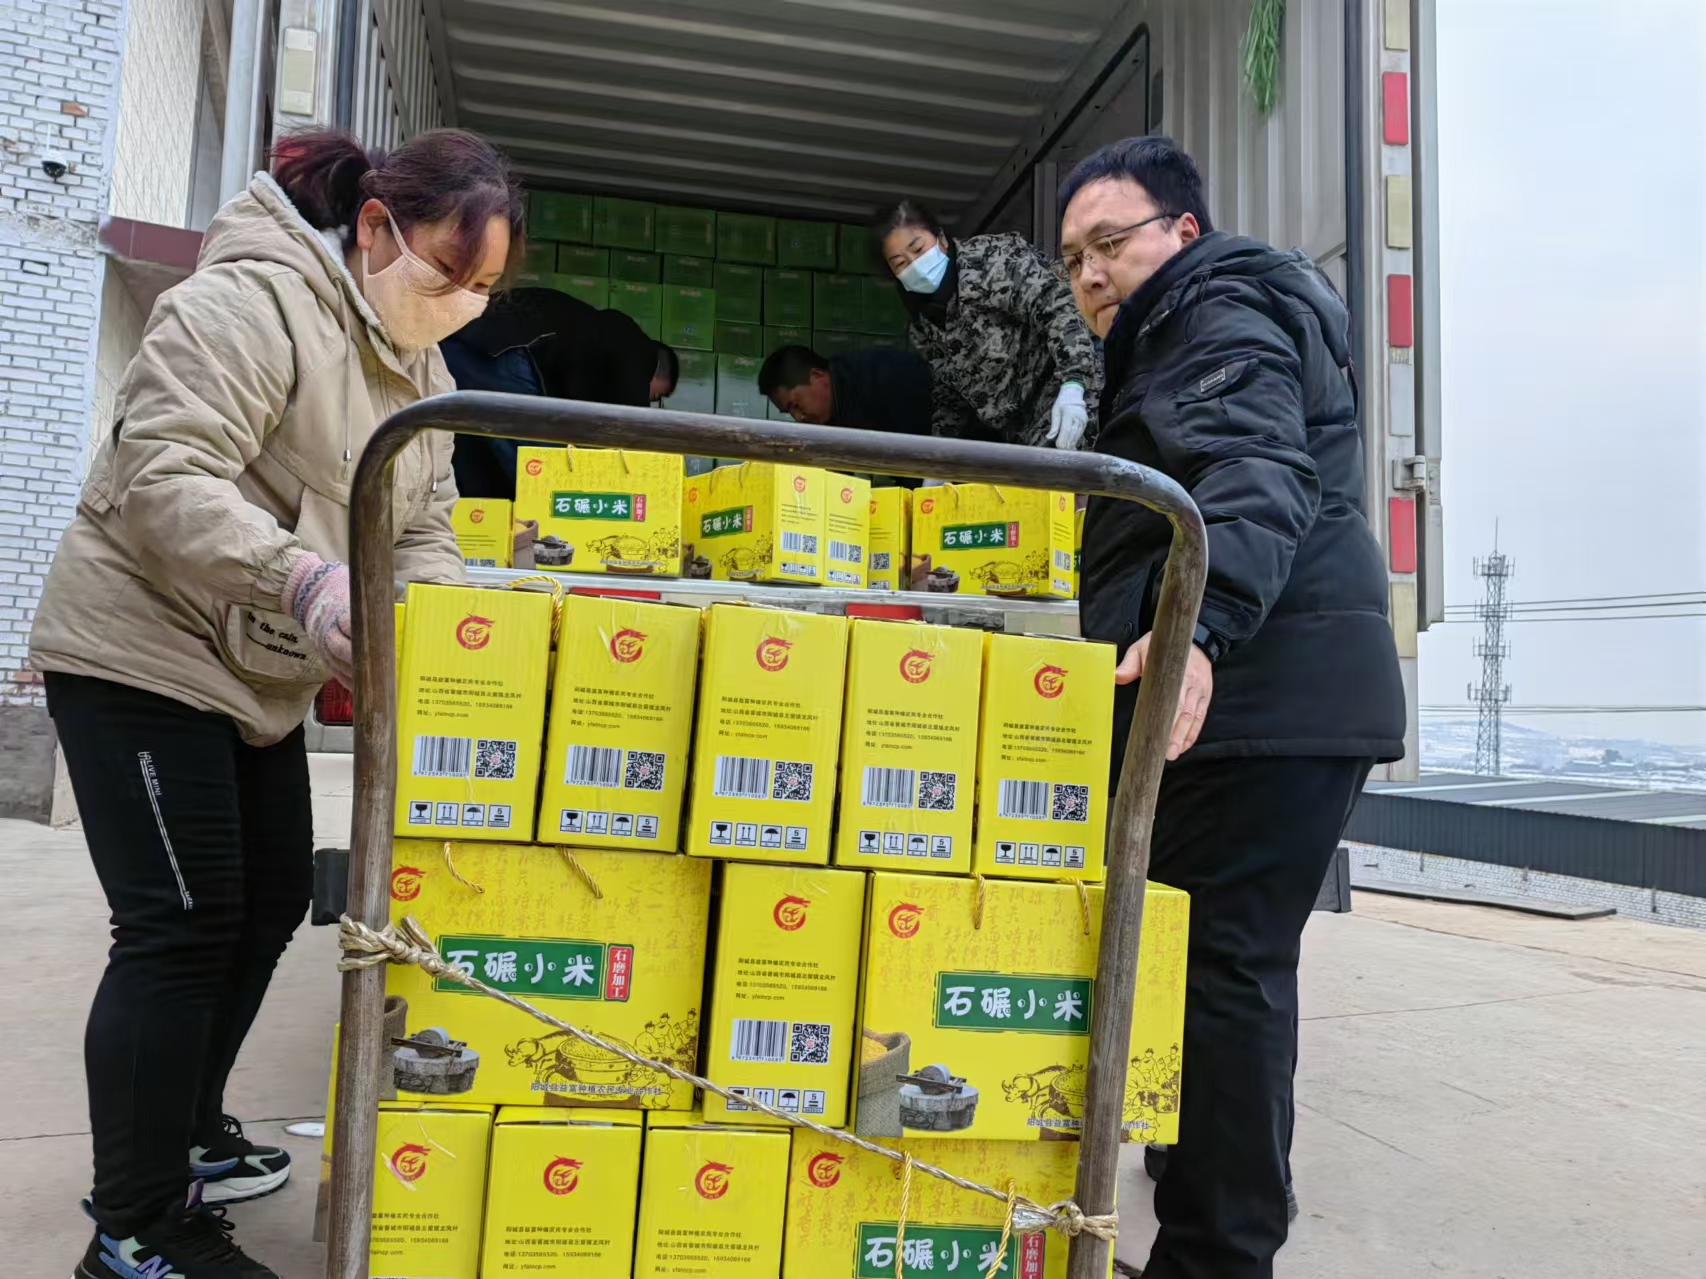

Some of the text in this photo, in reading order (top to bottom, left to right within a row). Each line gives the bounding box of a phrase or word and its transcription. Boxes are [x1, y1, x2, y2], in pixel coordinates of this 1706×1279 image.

[555, 497, 628, 515] 石碾小米
[702, 512, 743, 533] 石碾小米
[943, 527, 1004, 545] 石碾小米
[259, 622, 275, 635] the
[266, 643, 307, 660] unknown
[445, 948, 595, 987] 石碾小米
[610, 948, 626, 999] 石磨加工
[943, 984, 1084, 1022] 石碾小米
[530, 1081, 663, 1096] 阳城县益富种植农民专业合作社
[864, 1236, 1009, 1272] 石碾小米
